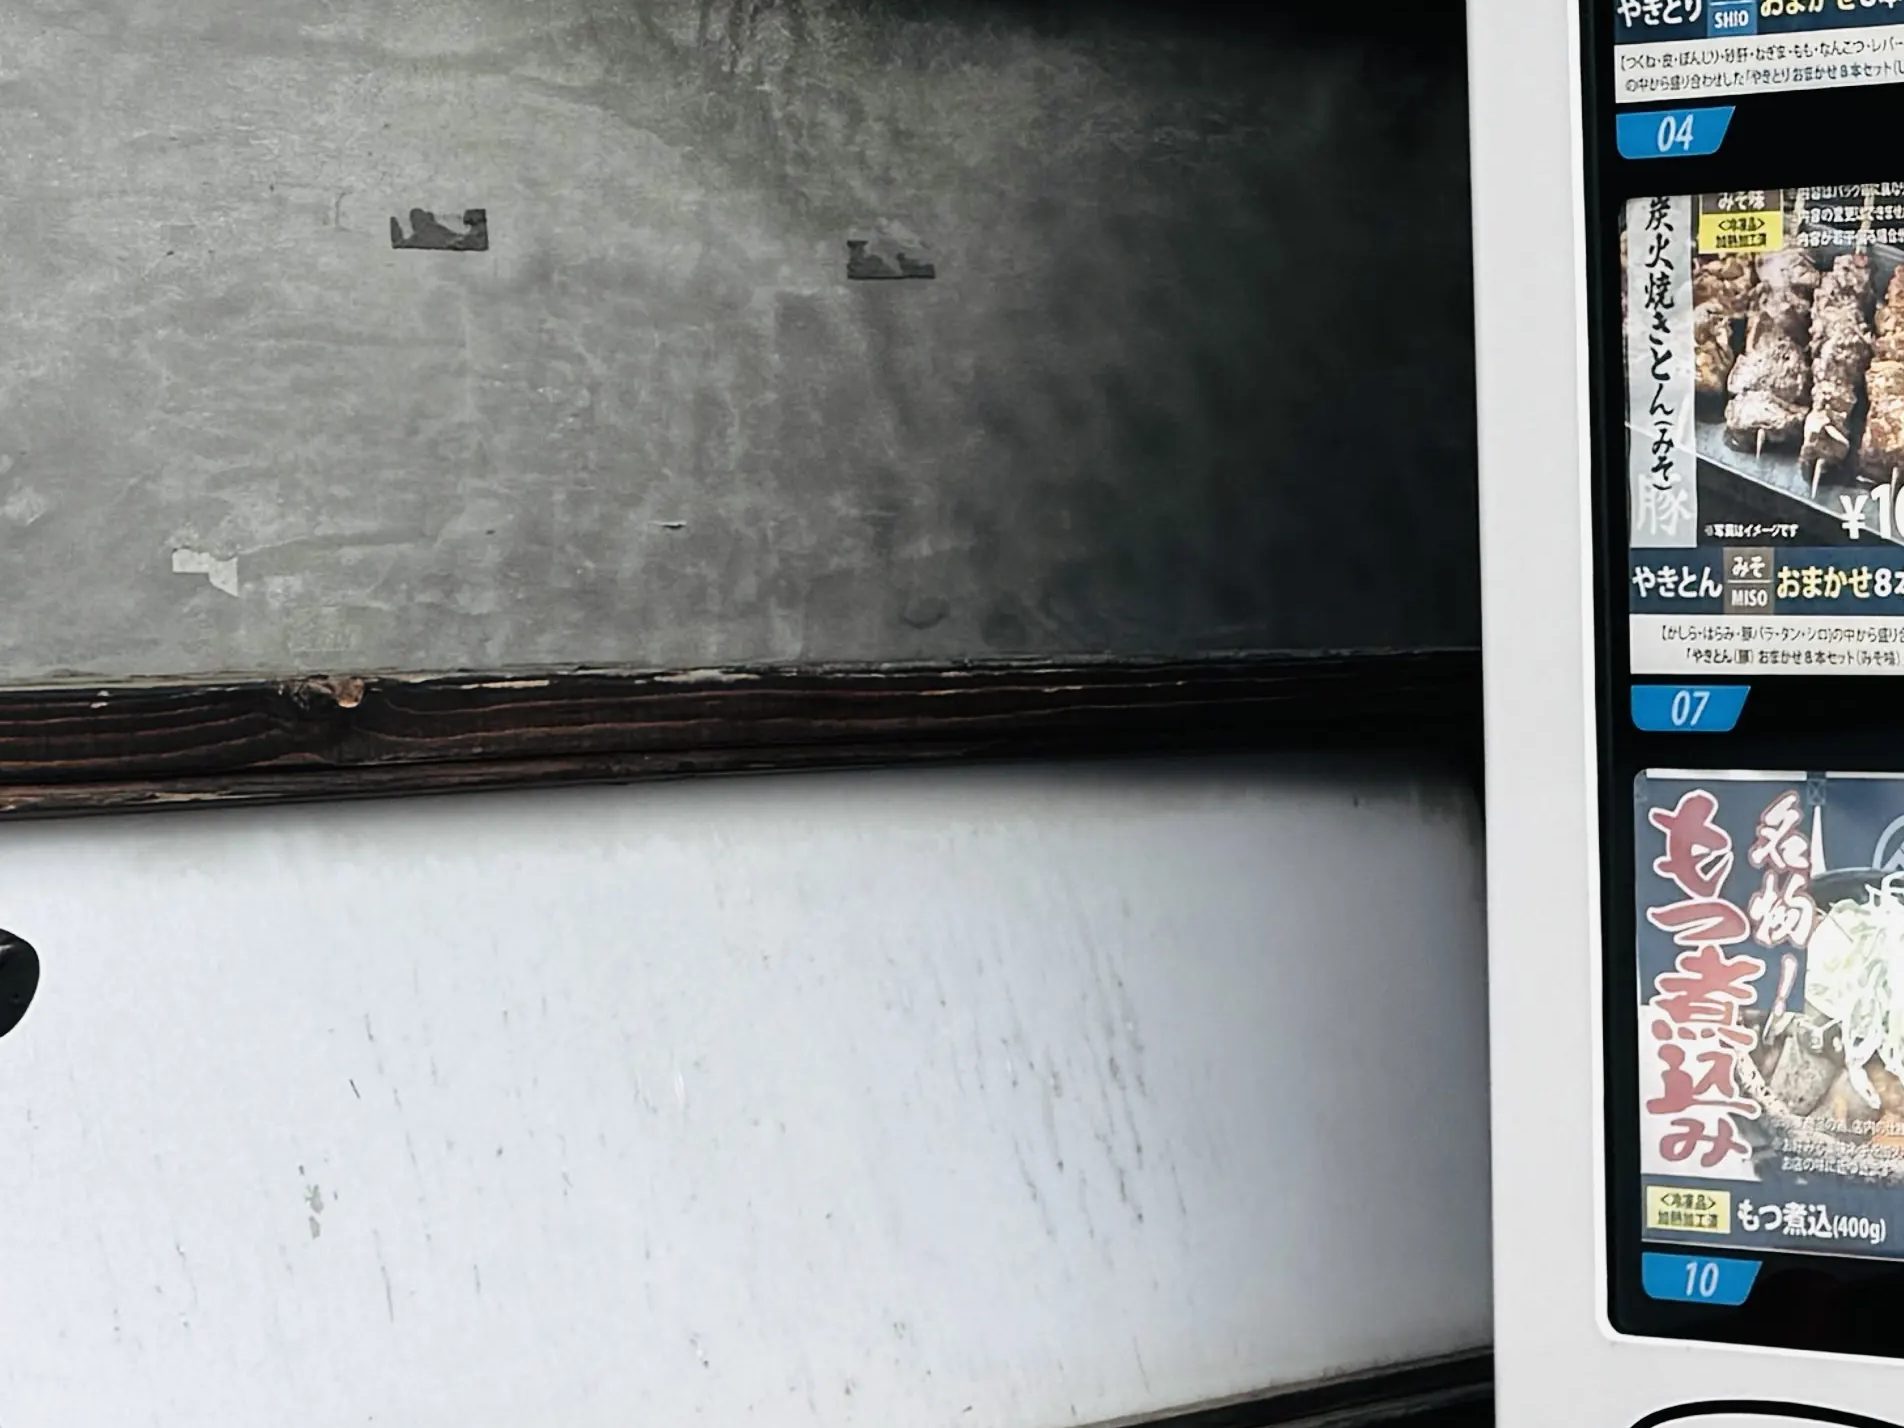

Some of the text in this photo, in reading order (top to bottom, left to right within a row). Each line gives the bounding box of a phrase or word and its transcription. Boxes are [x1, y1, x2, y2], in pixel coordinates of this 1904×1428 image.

[1713, 9, 1749, 29] SHIO
[1657, 114, 1694, 152] 04
[1632, 566, 1723, 599] やきとん
[1731, 555, 1765, 579] みそ
[1731, 588, 1768, 608] MISO
[1671, 690, 1710, 727] 07
[1646, 789, 1766, 1168] もつ煮込み
[1685, 1261, 1719, 1297] 10
